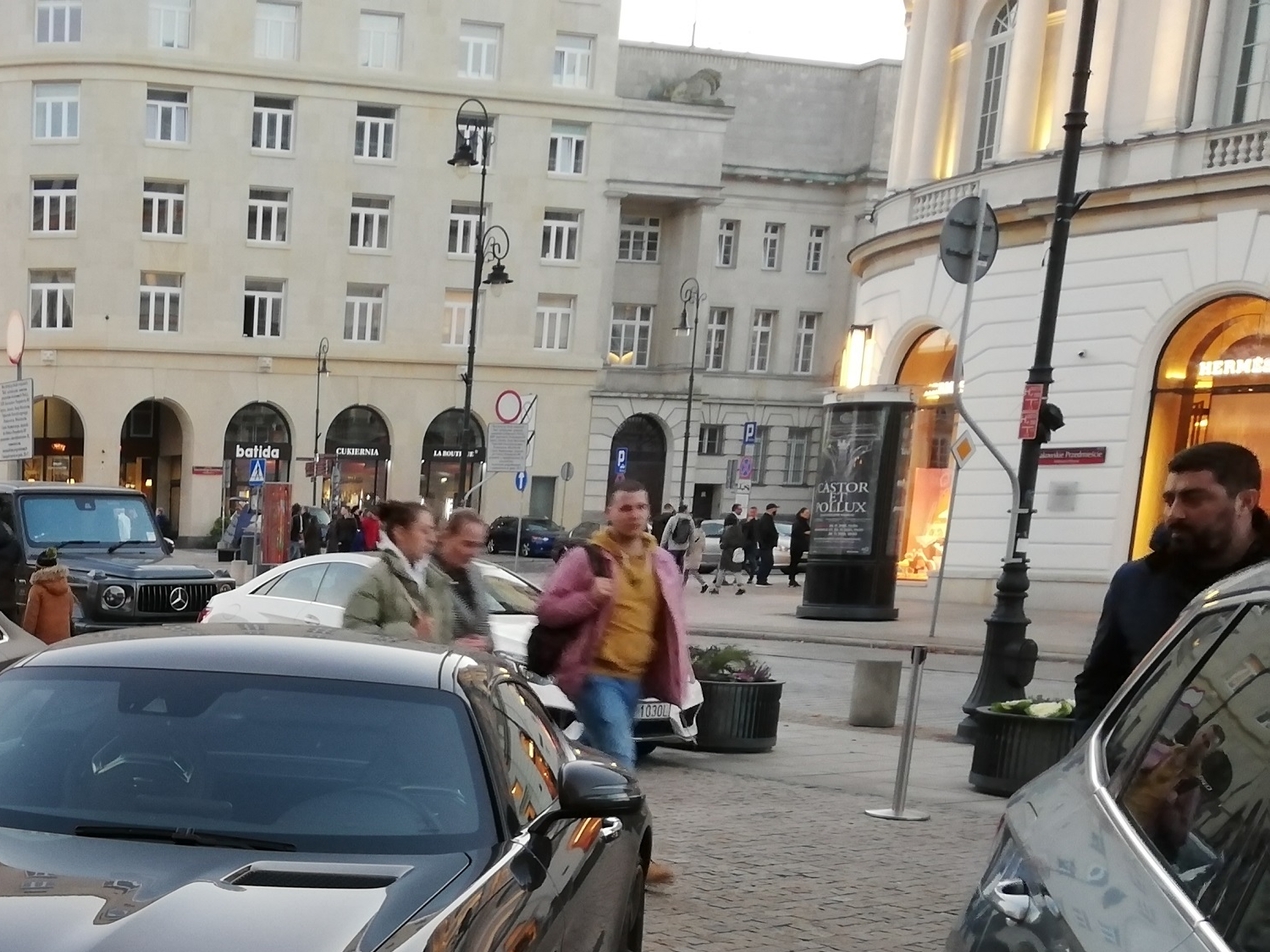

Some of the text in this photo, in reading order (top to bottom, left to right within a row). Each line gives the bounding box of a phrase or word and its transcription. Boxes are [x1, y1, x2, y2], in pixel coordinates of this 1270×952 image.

[236, 445, 280, 458] batida
[336, 447, 379, 456] CUKIERNIA
[818, 481, 870, 493] CASTOR
[830, 492, 848, 502] ET
